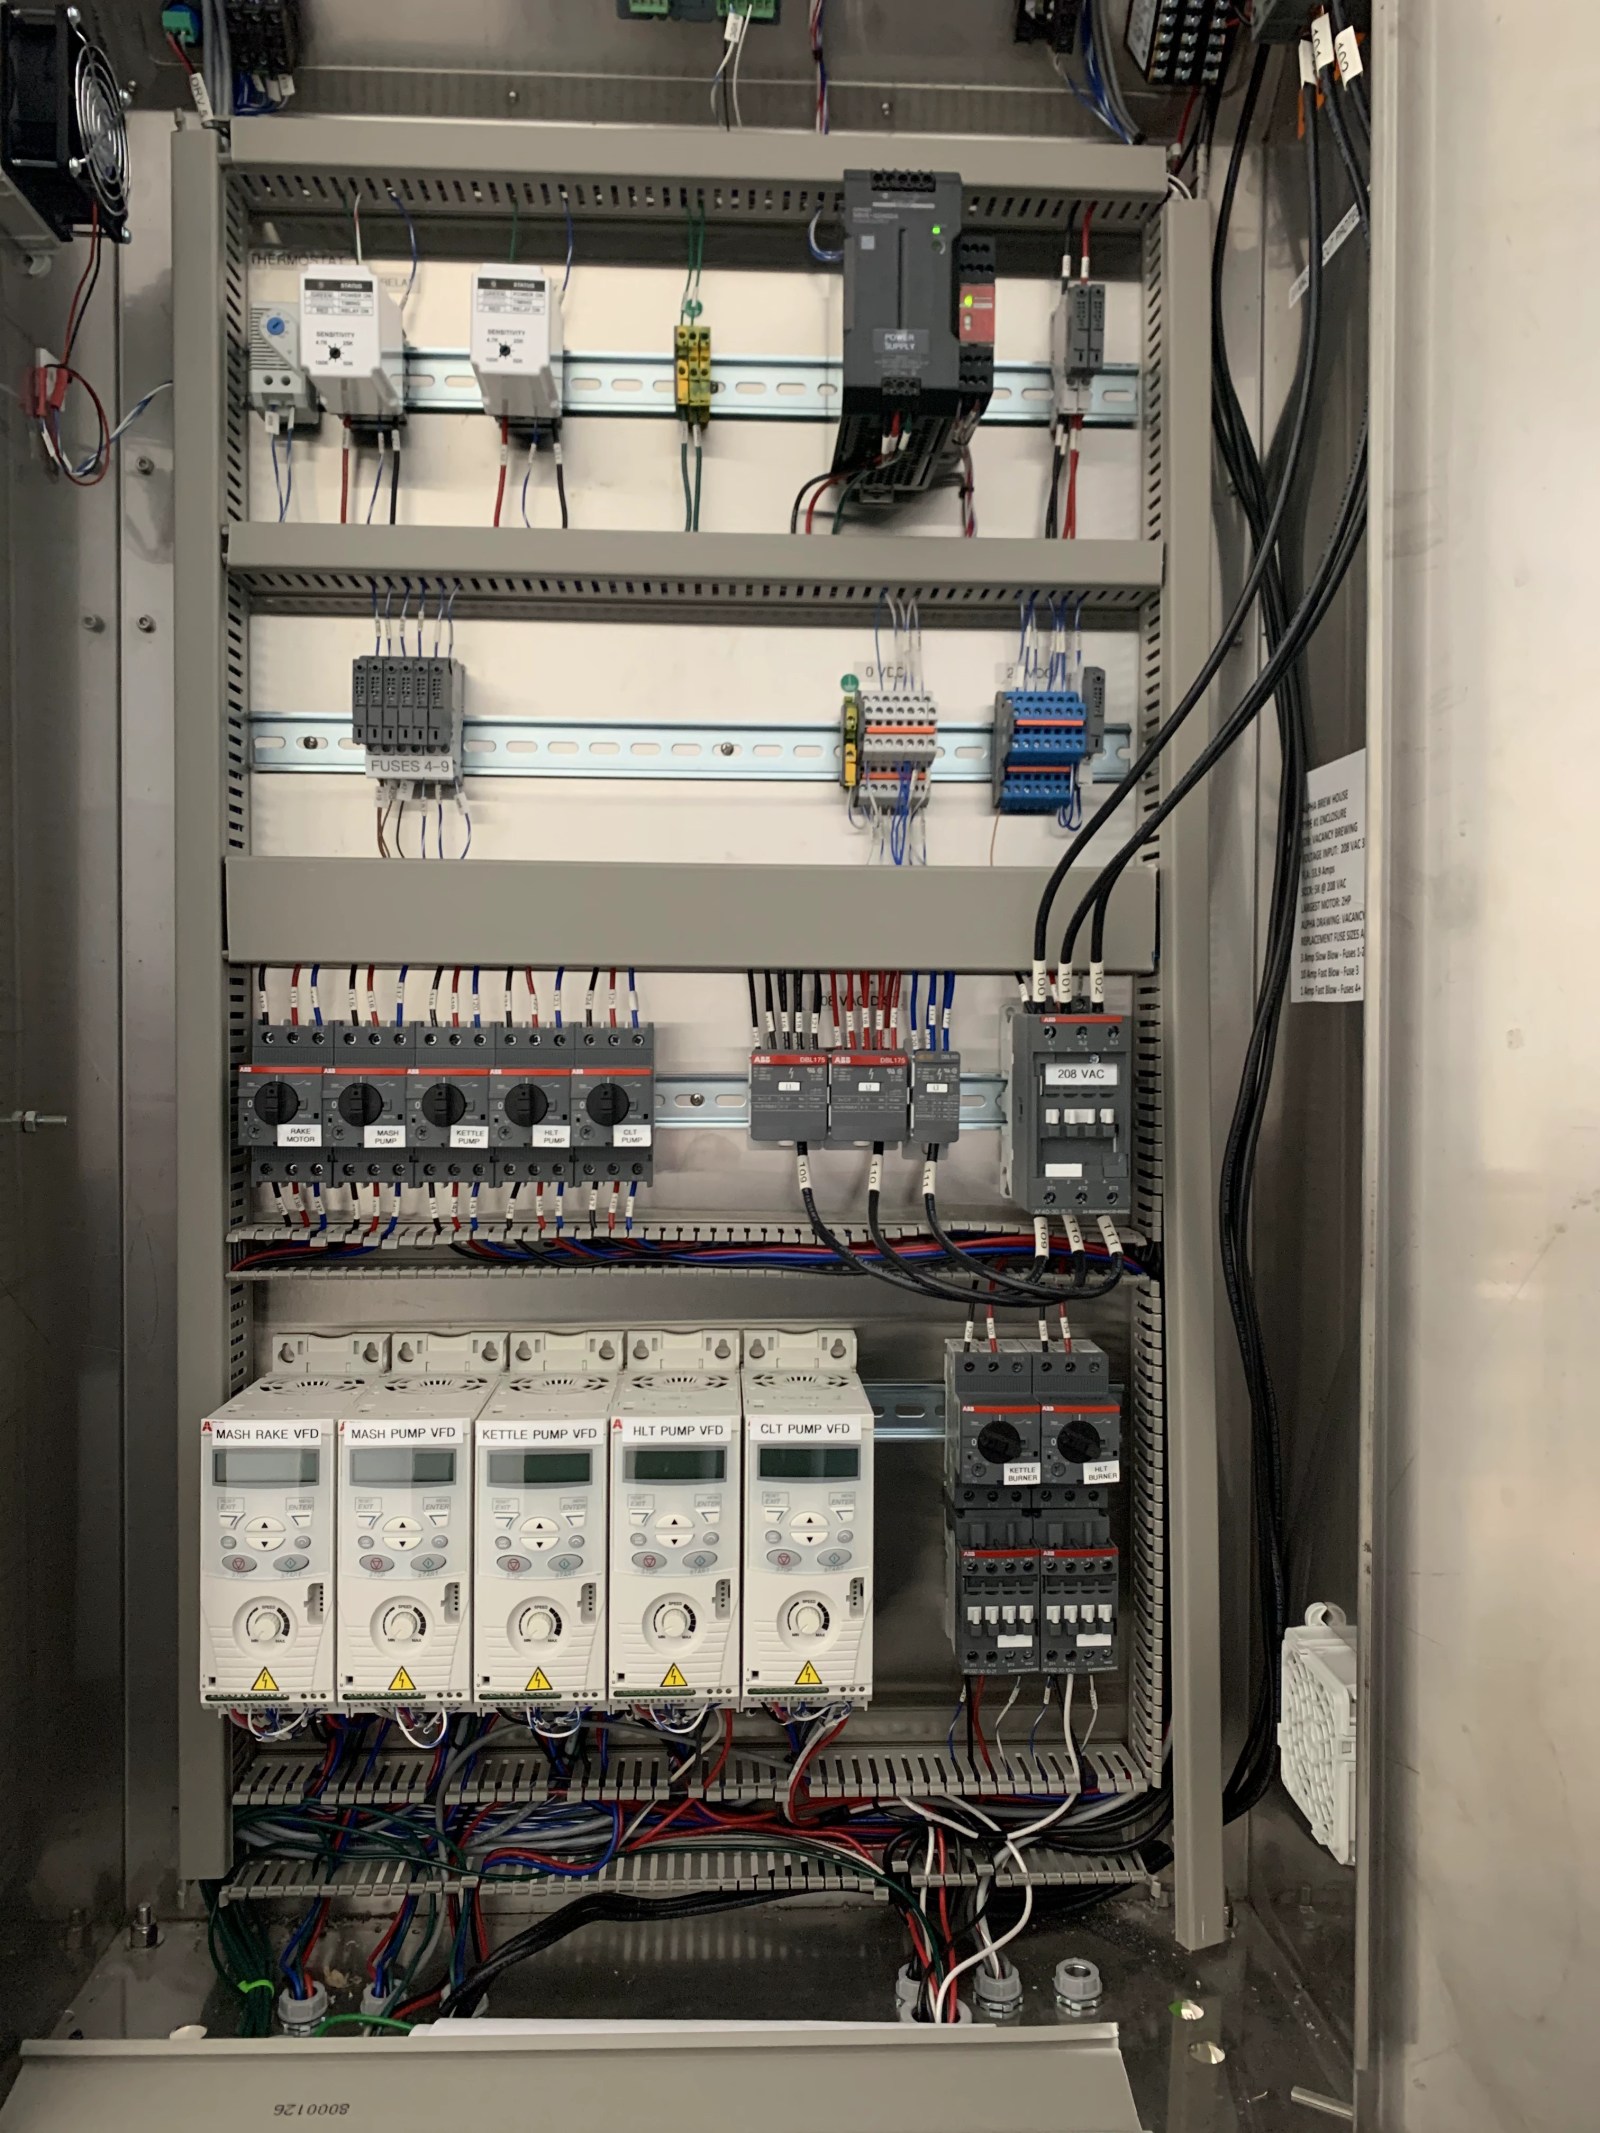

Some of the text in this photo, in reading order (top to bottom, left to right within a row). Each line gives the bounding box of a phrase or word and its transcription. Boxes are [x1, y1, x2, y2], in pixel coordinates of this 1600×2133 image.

[251, 253, 345, 265] THERMOSTAT
[884, 333, 914, 342] POWER
[884, 342, 916, 350] SUPPLY
[371, 760, 420, 772] FUSES
[1301, 932, 1333, 946] REPLACEMENT
[1037, 970, 1046, 996] 100
[1062, 971, 1071, 994] 101
[1095, 970, 1104, 995] 102
[834, 1056, 906, 1064] ABB DBL175
[1058, 1069, 1105, 1079] 208 VAC
[799, 1162, 807, 1183] 109
[869, 1161, 878, 1184] 110
[922, 1168, 931, 1188] 111
[1069, 1218, 1080, 1243] 110
[1104, 1223, 1119, 1246] 111
[216, 1429, 319, 1439] MASH RAKE VFD
[351, 1427, 456, 1439] MASH PUMP VFD
[482, 1428, 597, 1439] KETTLE PUMP VFD
[633, 1425, 723, 1436] HLT PUMP VFD
[760, 1423, 850, 1434] CLT PUMP VFD
[1088, 1473, 1118, 1481] BURNER
[273, 2103, 350, 2116] 8000126
